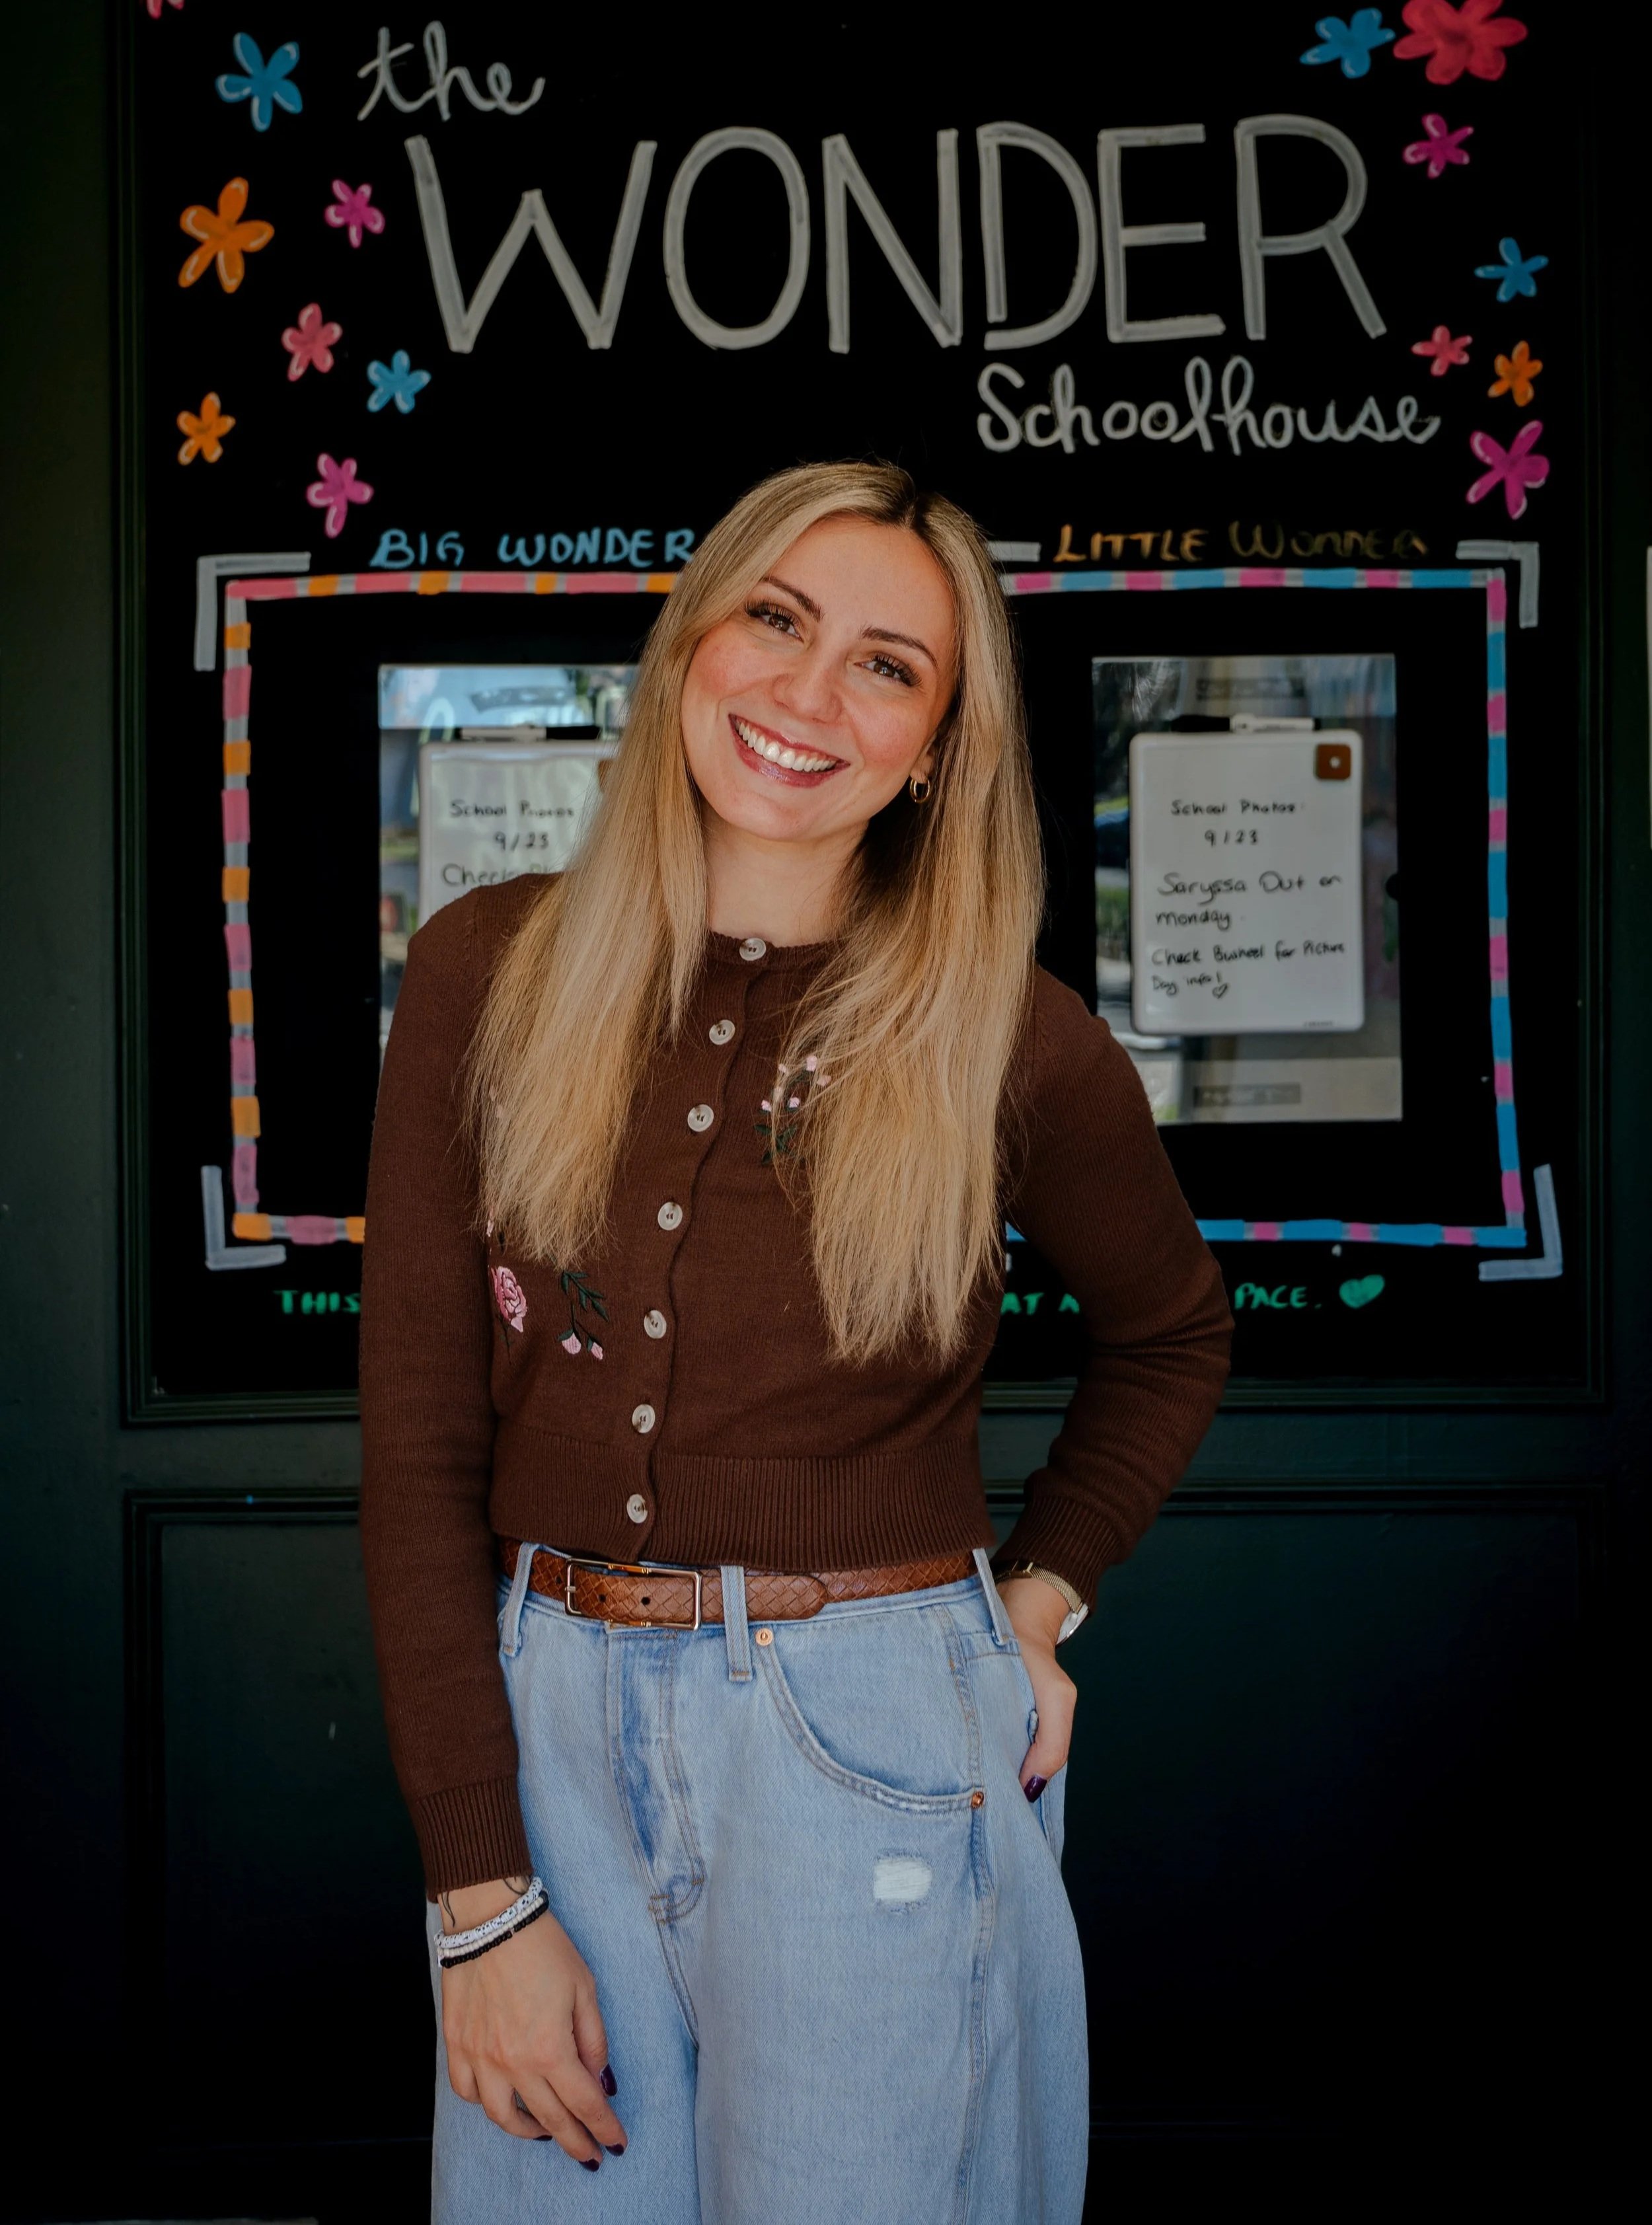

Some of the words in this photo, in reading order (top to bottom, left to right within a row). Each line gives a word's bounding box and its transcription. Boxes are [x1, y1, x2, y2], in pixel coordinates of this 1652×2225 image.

[357, 20, 546, 122] the
[404, 113, 1387, 354] WONDER
[976, 356, 1442, 456] Schoolhouse
[367, 527, 466, 570] BIG
[496, 525, 698, 569] WONDER
[1053, 523, 1209, 563] LITTLE
[1171, 799, 1226, 815] School
[1259, 870, 1304, 893] Out
[1151, 948, 1201, 965] Check
[273, 1289, 361, 1316] THIS
